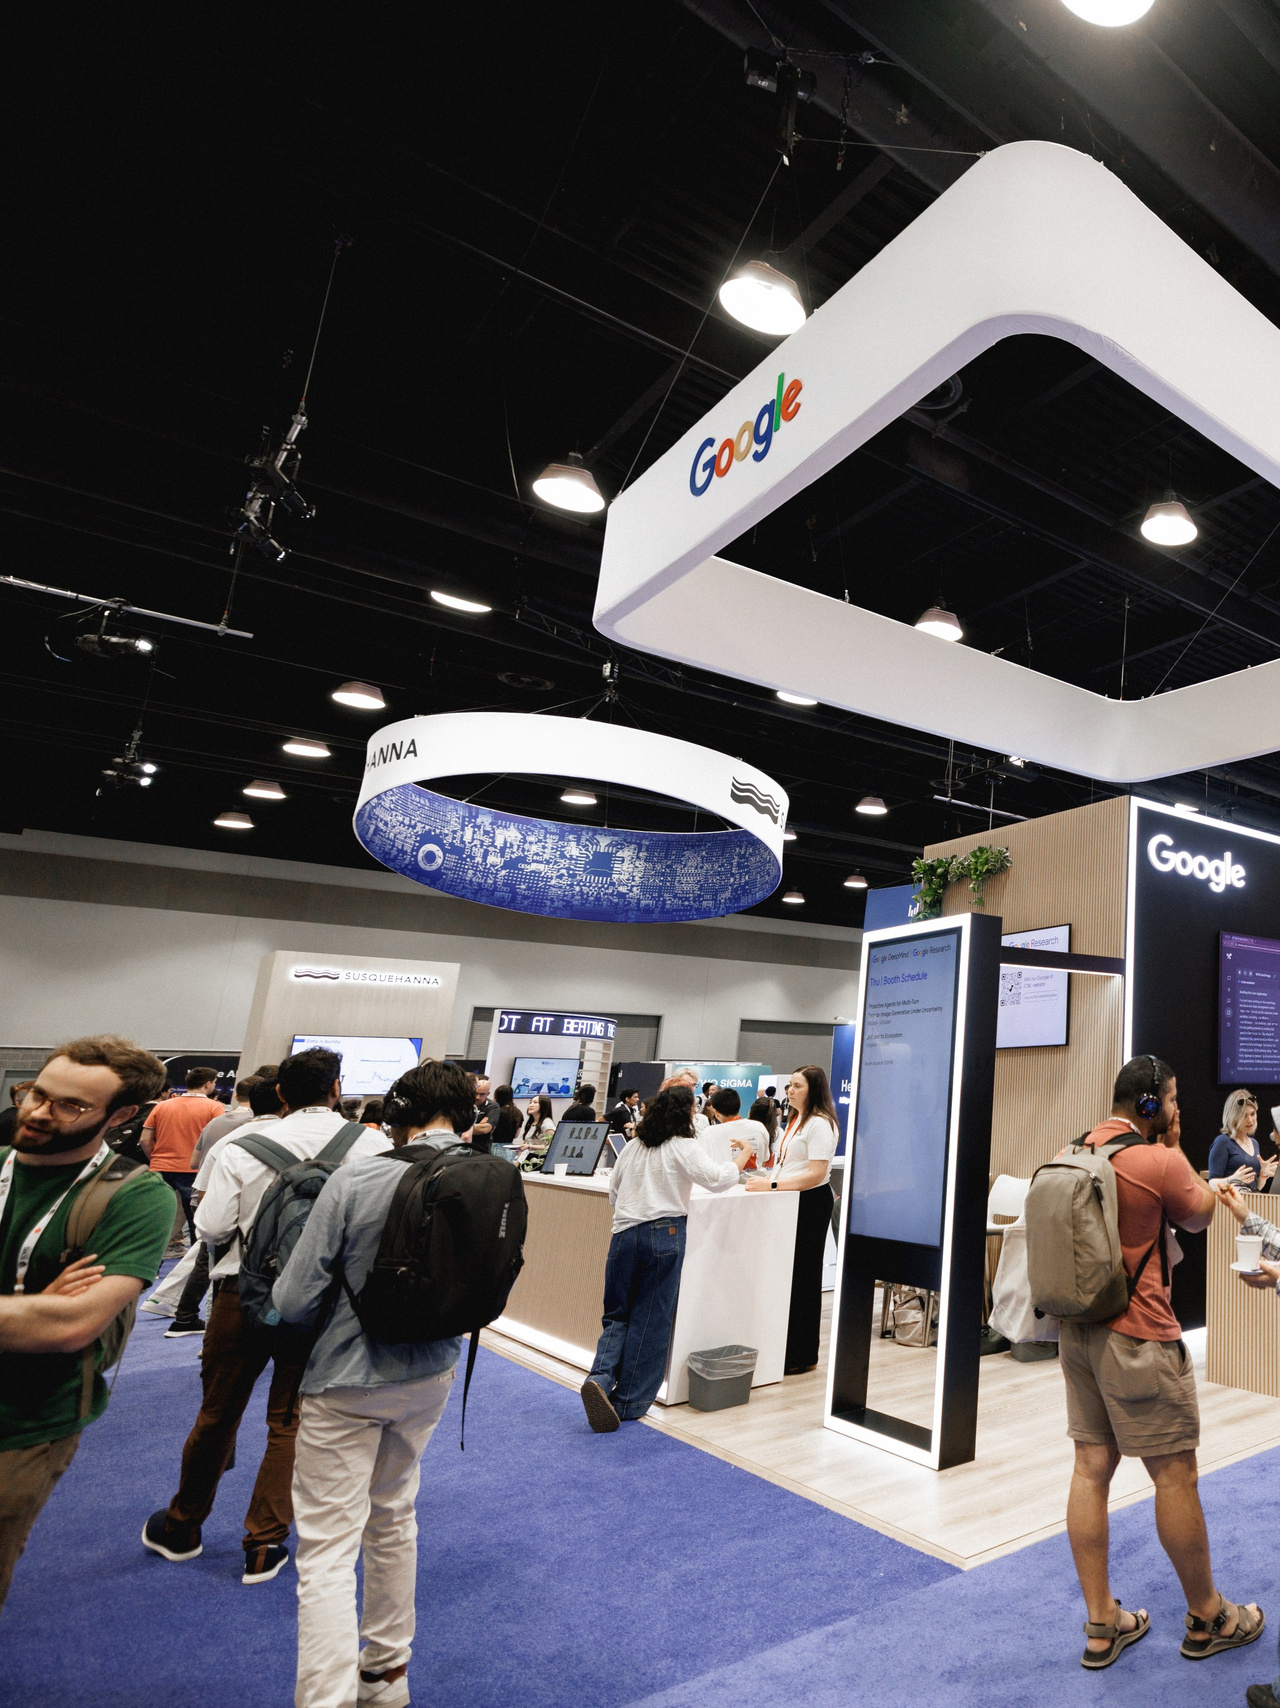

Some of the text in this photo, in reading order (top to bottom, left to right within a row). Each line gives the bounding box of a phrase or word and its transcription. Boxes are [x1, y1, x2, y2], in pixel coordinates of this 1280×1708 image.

[690, 372, 803, 497] Google
[1147, 834, 1246, 893] Google
[1031, 936, 1059, 947] Research
[872, 944, 951, 963] Google DeepMind Google Research
[345, 972, 440, 985] SUSQUEHANNA
[870, 971, 927, 986] Thu Booth Schedule
[531, 1017, 554, 1032] AT
[562, 1018, 604, 1036] BEATING
[720, 1079, 752, 1087] SIGMA
